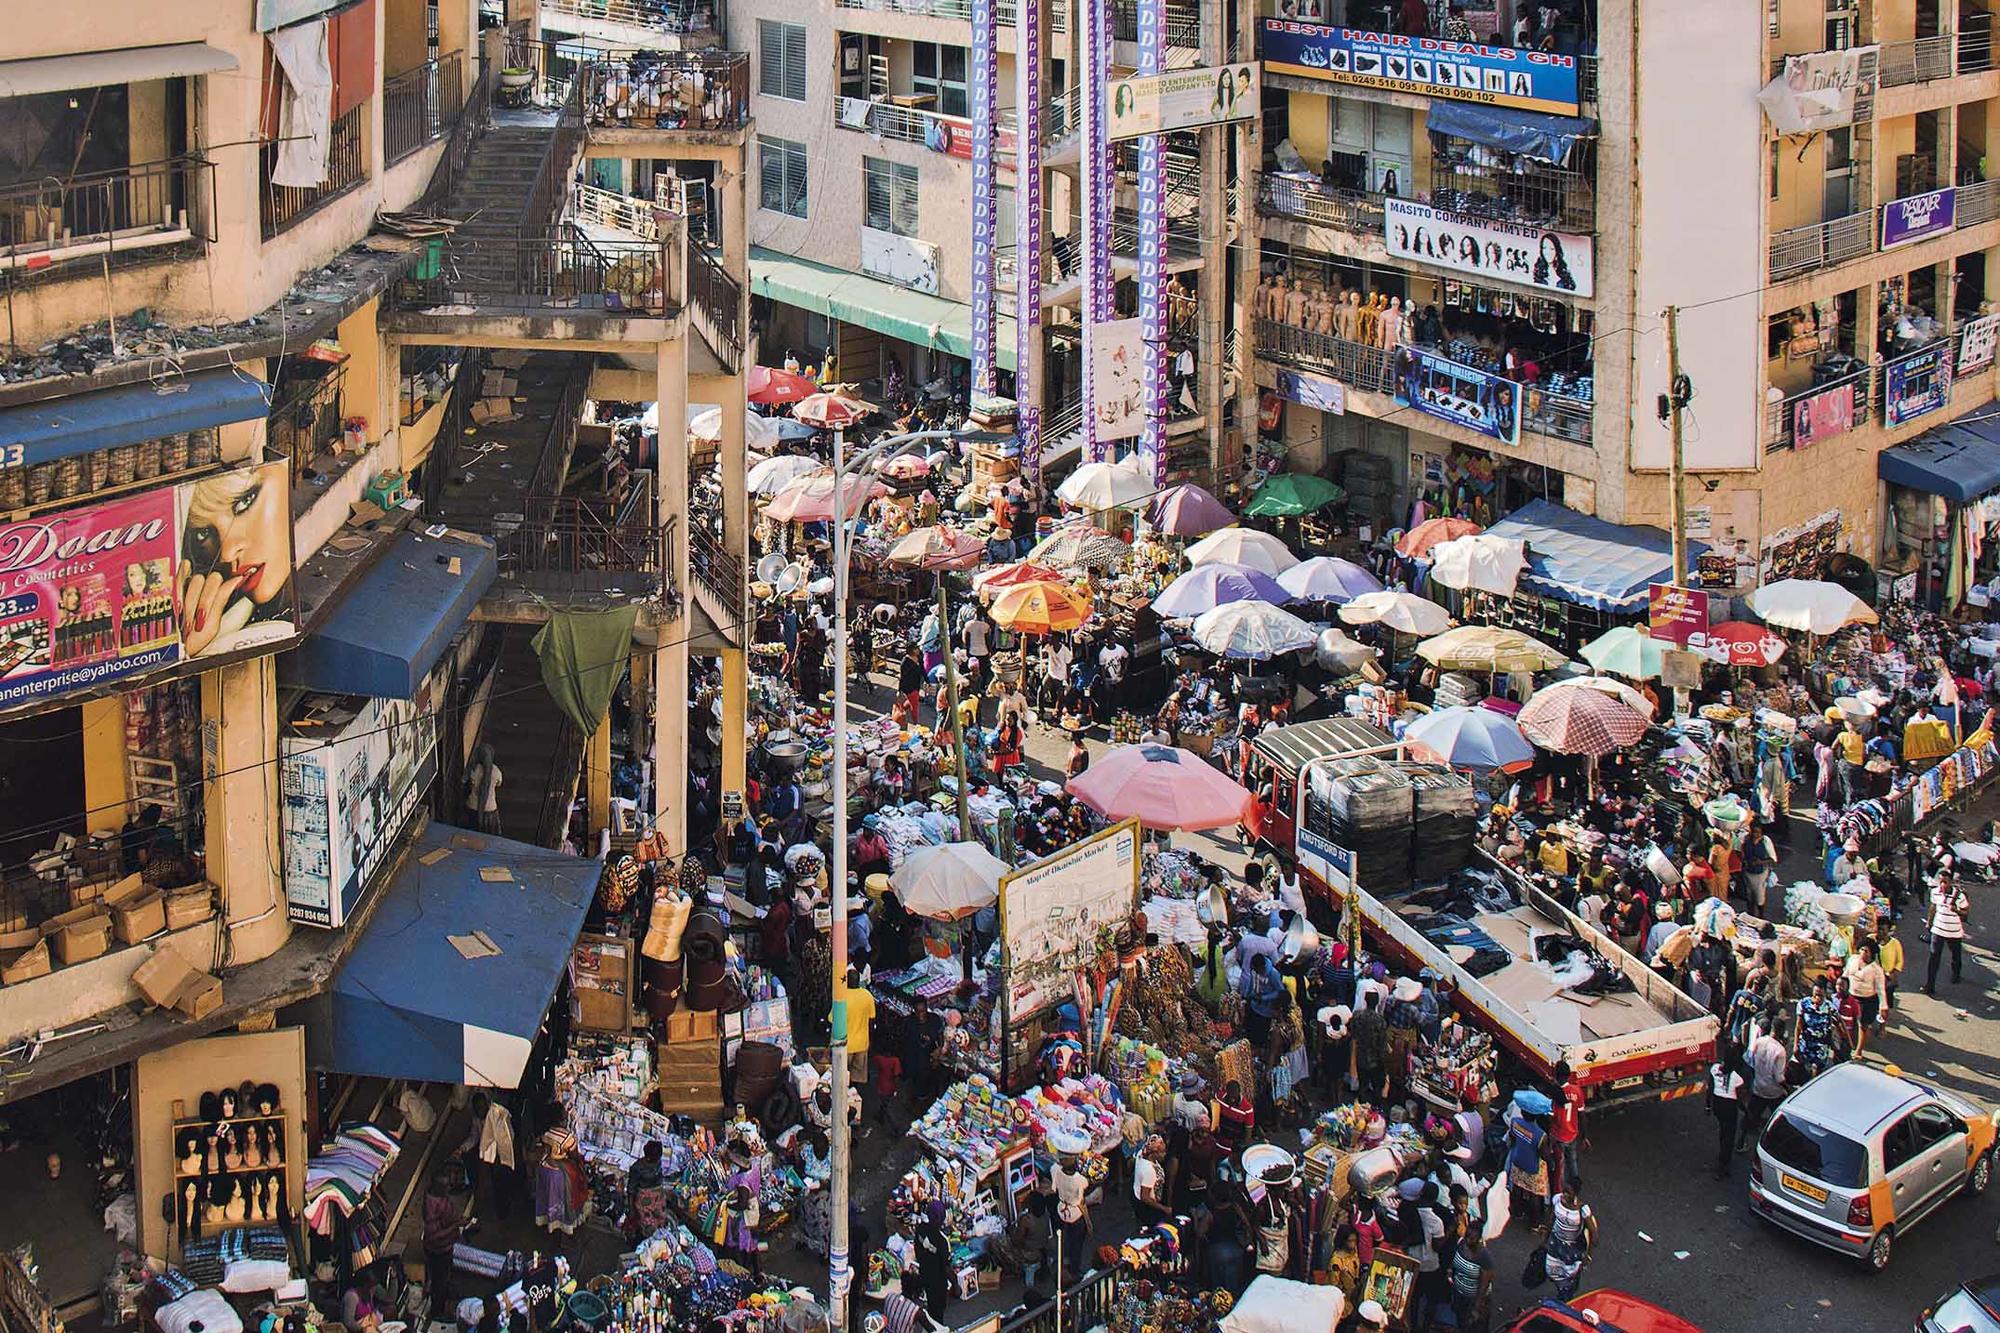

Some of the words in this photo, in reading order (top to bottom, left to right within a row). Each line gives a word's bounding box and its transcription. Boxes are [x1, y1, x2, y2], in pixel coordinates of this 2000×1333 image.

[1267, 20, 1335, 38] BEST
[1342, 29, 1411, 49] HAIR
[1420, 38, 1516, 60] DEALS
[1527, 52, 1574, 68] GH
[1332, 72, 1350, 82] Tel:
[1352, 75, 1376, 85] 0249
[1379, 78, 1396, 88] 516
[1399, 81, 1417, 91] 095
[1426, 85, 1450, 96] 0543
[1453, 88, 1473, 98] 090
[1476, 92, 1496, 102] 102
[1390, 202, 1432, 219] MASITO
[1435, 210, 1489, 231] COMPANY
[14, 561, 96, 588] Cosmetics
[1301, 831, 1338, 857] KNUTSFORD
[1026, 874, 1042, 886] Map
[1042, 869, 1051, 878] of
[1611, 1044, 1658, 1057] DAEWOO
